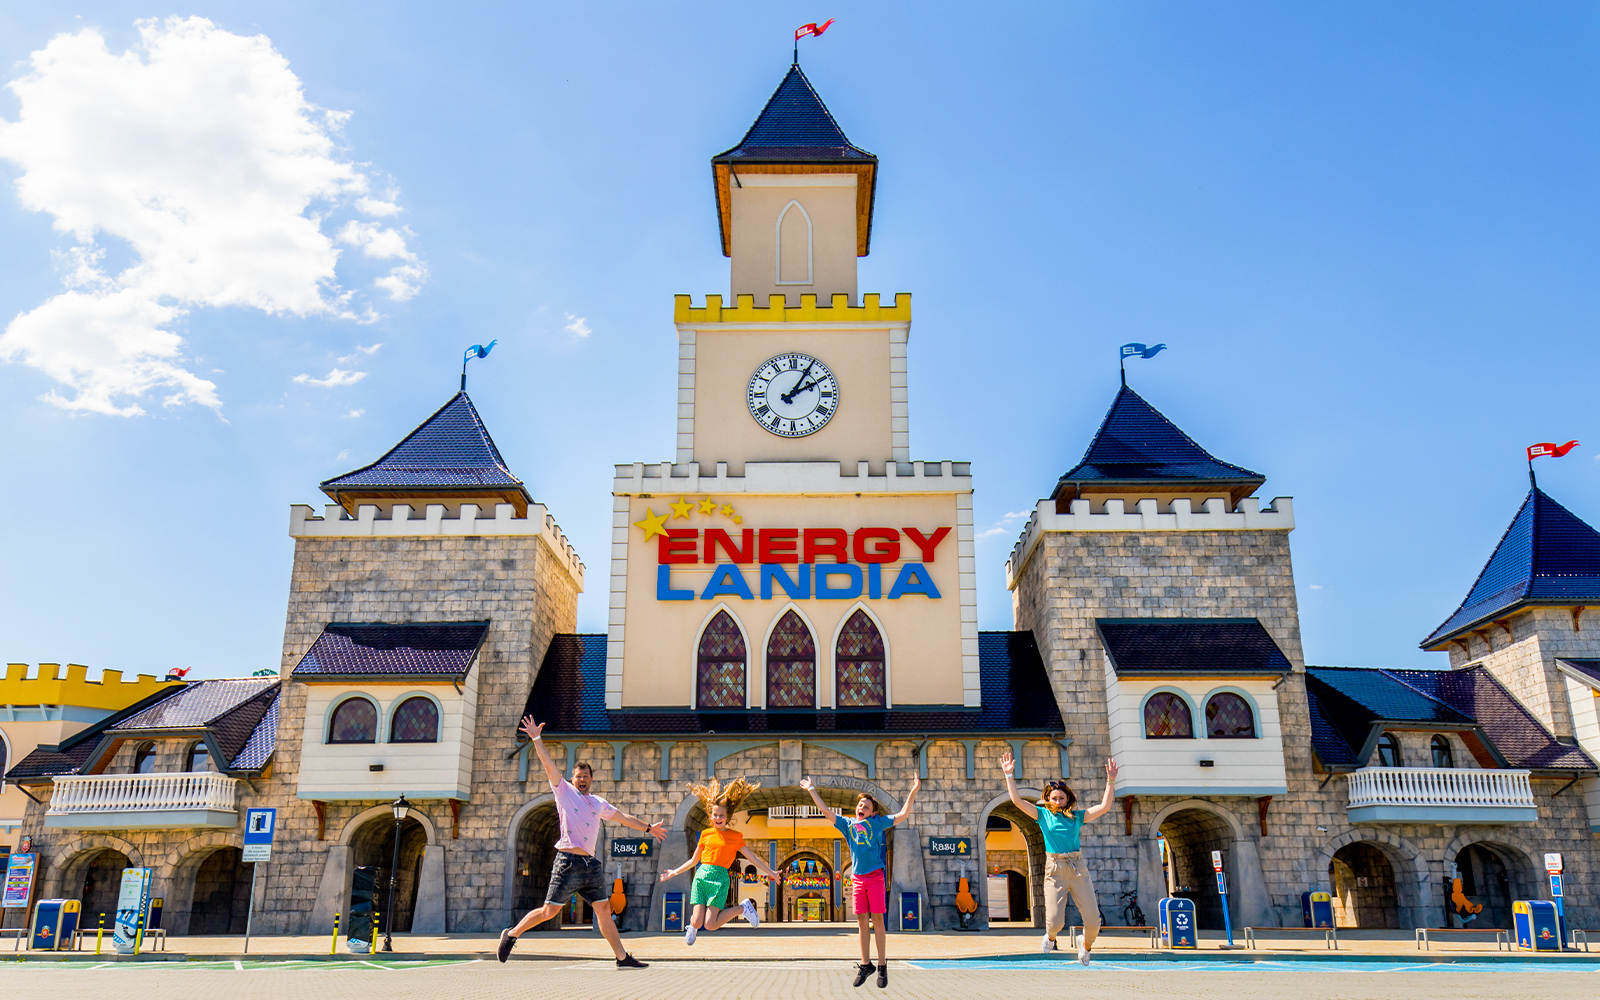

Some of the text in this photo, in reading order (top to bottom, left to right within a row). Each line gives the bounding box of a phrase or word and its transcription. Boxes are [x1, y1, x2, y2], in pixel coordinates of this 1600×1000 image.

[797, 26, 813, 37] EL
[1123, 346, 1142, 355] EL
[1530, 446, 1552, 456] EL
[658, 527, 952, 564] ENERGY
[657, 563, 942, 600] LANDIA
[815, 775, 878, 797] LANDIA
[614, 841, 637, 855] kasy
[931, 840, 956, 854] kasy
